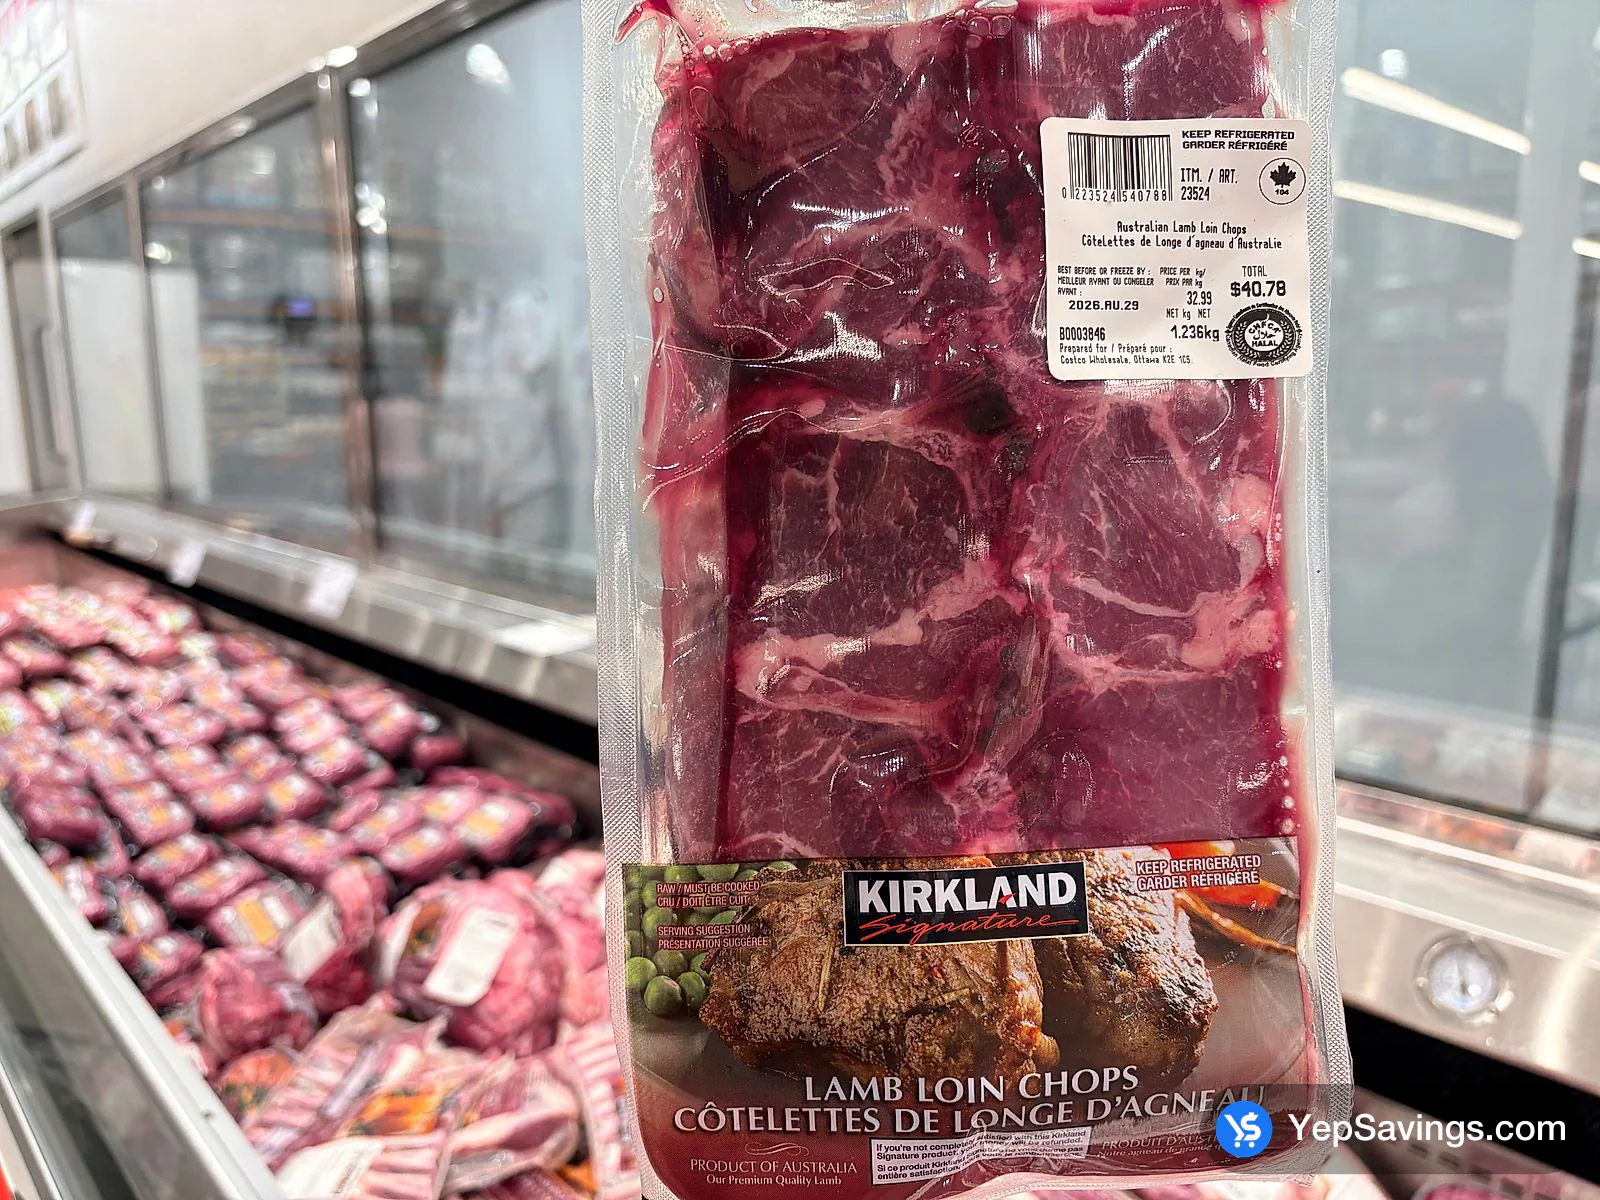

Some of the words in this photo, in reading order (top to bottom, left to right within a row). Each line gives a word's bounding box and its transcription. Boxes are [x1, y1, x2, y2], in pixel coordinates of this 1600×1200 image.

[1182, 130, 1211, 138] KEEP
[1214, 130, 1295, 140] REFRIGERATED
[1183, 141, 1225, 149] GARDER
[1228, 140, 1288, 150] RÉFRIGÉRÉ
[1181, 168, 1202, 182] ITM.
[1208, 168, 1214, 182] /
[1219, 169, 1238, 183] ART.
[1075, 188, 1116, 202] 223524
[1122, 190, 1167, 202] 540788
[1181, 186, 1210, 201] 23524
[1117, 220, 1169, 233] Australian
[1173, 220, 1196, 233] Lamb
[1200, 221, 1218, 234] Loin
[1222, 222, 1247, 237] Chops
[1082, 234, 1135, 247] Côtelettes
[1140, 235, 1151, 247] de
[1156, 235, 1182, 249] Longe
[1186, 235, 1225, 250] d'agneau
[1229, 236, 1282, 249] d'Australie
[1057, 265, 1071, 275] BEST
[1074, 267, 1097, 275] BEFORE
[1099, 267, 1108, 275] OR
[1110, 267, 1134, 275] FREEZE
[1137, 267, 1146, 275] BY
[1160, 267, 1177, 276] PRICE
[1180, 267, 1191, 276] PER
[1242, 265, 1268, 277] TOTAL
[1057, 276, 1086, 286] MEILLEUR
[1113, 278, 1122, 286] OU
[1124, 278, 1154, 286] CONGELER
[1166, 278, 1180, 286] PRIX
[1182, 278, 1193, 286] PAR
[1195, 278, 1203, 288] kg
[1230, 280, 1286, 298] $40.78
[1187, 291, 1212, 306] 32.99
[1068, 300, 1139, 311] 2026.AU.29
[1166, 308, 1179, 318] NET
[1182, 309, 1191, 320] kg
[1198, 308, 1211, 319] NET
[1170, 325, 1220, 342] 1.236kg
[1059, 343, 1092, 354] Prepared
[1096, 343, 1108, 353] for
[1118, 343, 1147, 355] Préparé
[1150, 345, 1166, 354] pour
[1060, 355, 1086, 364] Costco
[1089, 355, 1131, 365] Wholesale,
[1134, 355, 1160, 364] Ottawa
[1162, 355, 1175, 364] K2E
[1136, 861, 1168, 875] KEEP
[1171, 855, 1261, 873] REFRIGERATED
[1138, 875, 1187, 891] GARDER
[1191, 868, 1260, 887] RÉFRIGÉRÉ
[657, 883, 676, 894] RAW
[684, 883, 709, 894] MUST
[711, 883, 722, 893] BE
[724, 881, 760, 892] COOKED
[858, 871, 1078, 914] KIRKLAND
[657, 897, 675, 907] CRU
[683, 896, 703, 907] DOIT
[705, 895, 727, 906] ÊTRE
[729, 895, 748, 906] CUIT
[658, 926, 694, 936] SERVING
[695, 924, 751, 936] SUGGESTION
[859, 911, 1080, 945] Signature
[658, 937, 721, 950] PRÉSENTATION
[722, 936, 769, 948] SUGGÉRÉE
[805, 1076, 903, 1102] LAMB
[918, 1076, 1004, 1103] LOIN
[1018, 1065, 1139, 1101] CHOPS
[674, 1101, 881, 1133] CÔTELETTES
[895, 1109, 939, 1133] DE
[955, 1102, 1073, 1133] LONGE
[877, 1143, 883, 1152] If
[884, 1144, 912, 1153] you're
[929, 1138, 975, 1152] completely
[1051, 1130, 1086, 1138] Kirkland
[1101, 1138, 1166, 1150] PRODUIT
[877, 1153, 920, 1161] Signature
[690, 1159, 757, 1173] PRODUCT
[760, 1161, 779, 1173] OF
[782, 1161, 858, 1174] AUSTRALIA
[877, 1164, 886, 1172] Si
[900, 1163, 930, 1173] produit
[706, 1174, 725, 1184] Our
[728, 1174, 773, 1185] Premium
[775, 1174, 812, 1188] Quality
[814, 1176, 842, 1185] Lamb
[877, 1172, 908, 1180] entière
